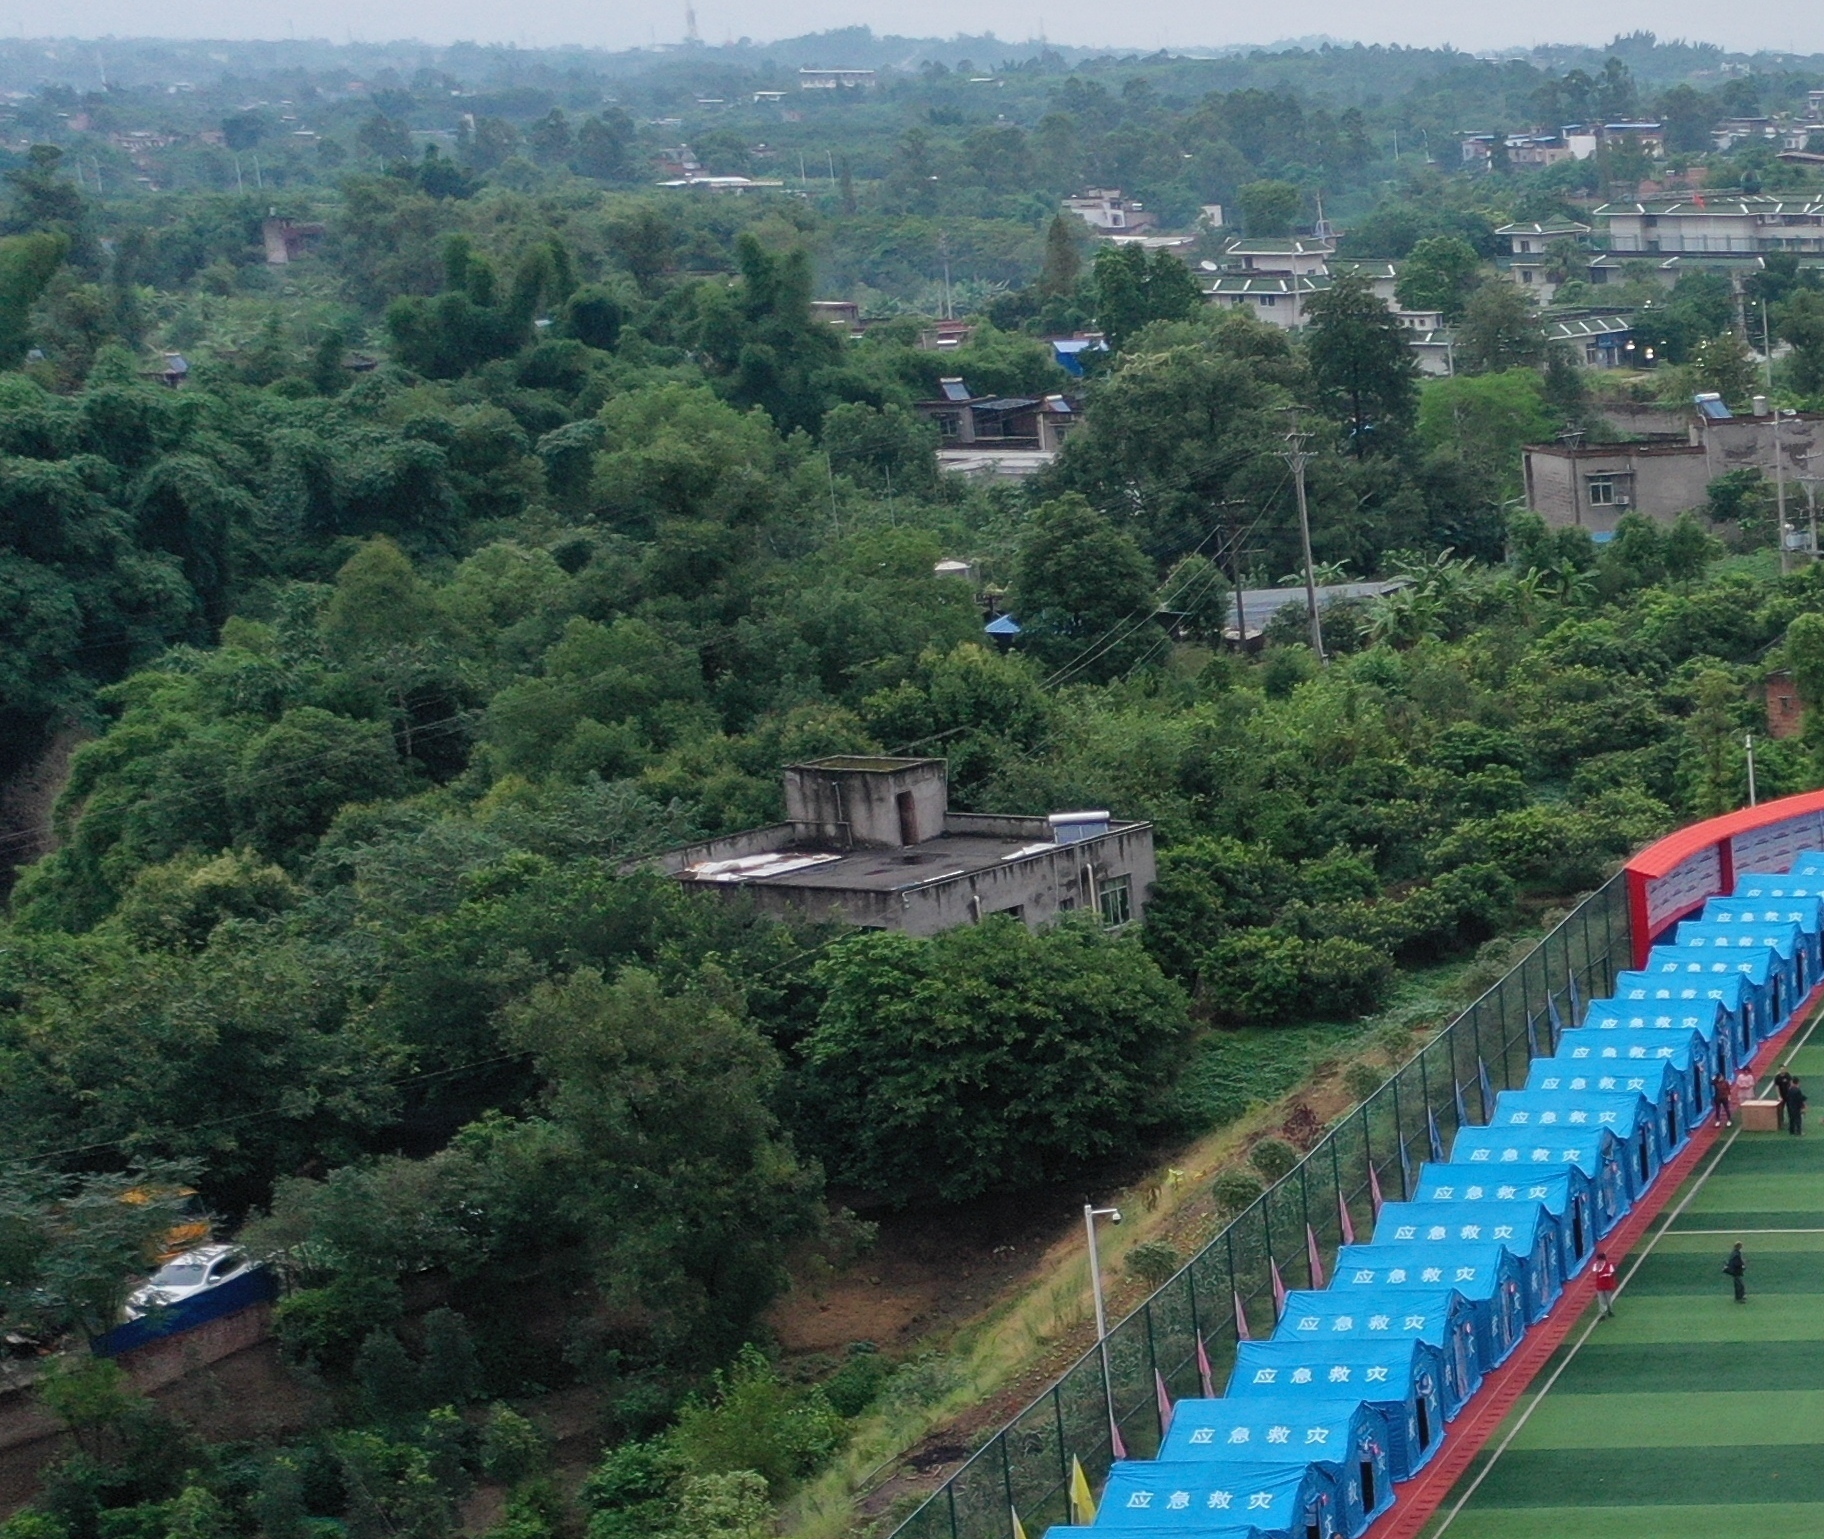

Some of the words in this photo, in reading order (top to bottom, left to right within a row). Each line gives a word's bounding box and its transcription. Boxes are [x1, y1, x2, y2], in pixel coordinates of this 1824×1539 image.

[1511, 1110, 1615, 1124] 应急救灾
[1470, 1147, 1581, 1162] 应急救灾
[1433, 1185, 1548, 1199] 应急救灾
[1395, 1225, 1513, 1242] 应急救灾
[1353, 1268, 1475, 1285] 应急救灾
[1297, 1315, 1426, 1332] 应急救灾
[1252, 1366, 1389, 1384] 应急救灾
[1190, 1427, 1329, 1446] 应急救灾
[1127, 1490, 1273, 1510] 应急救灾
